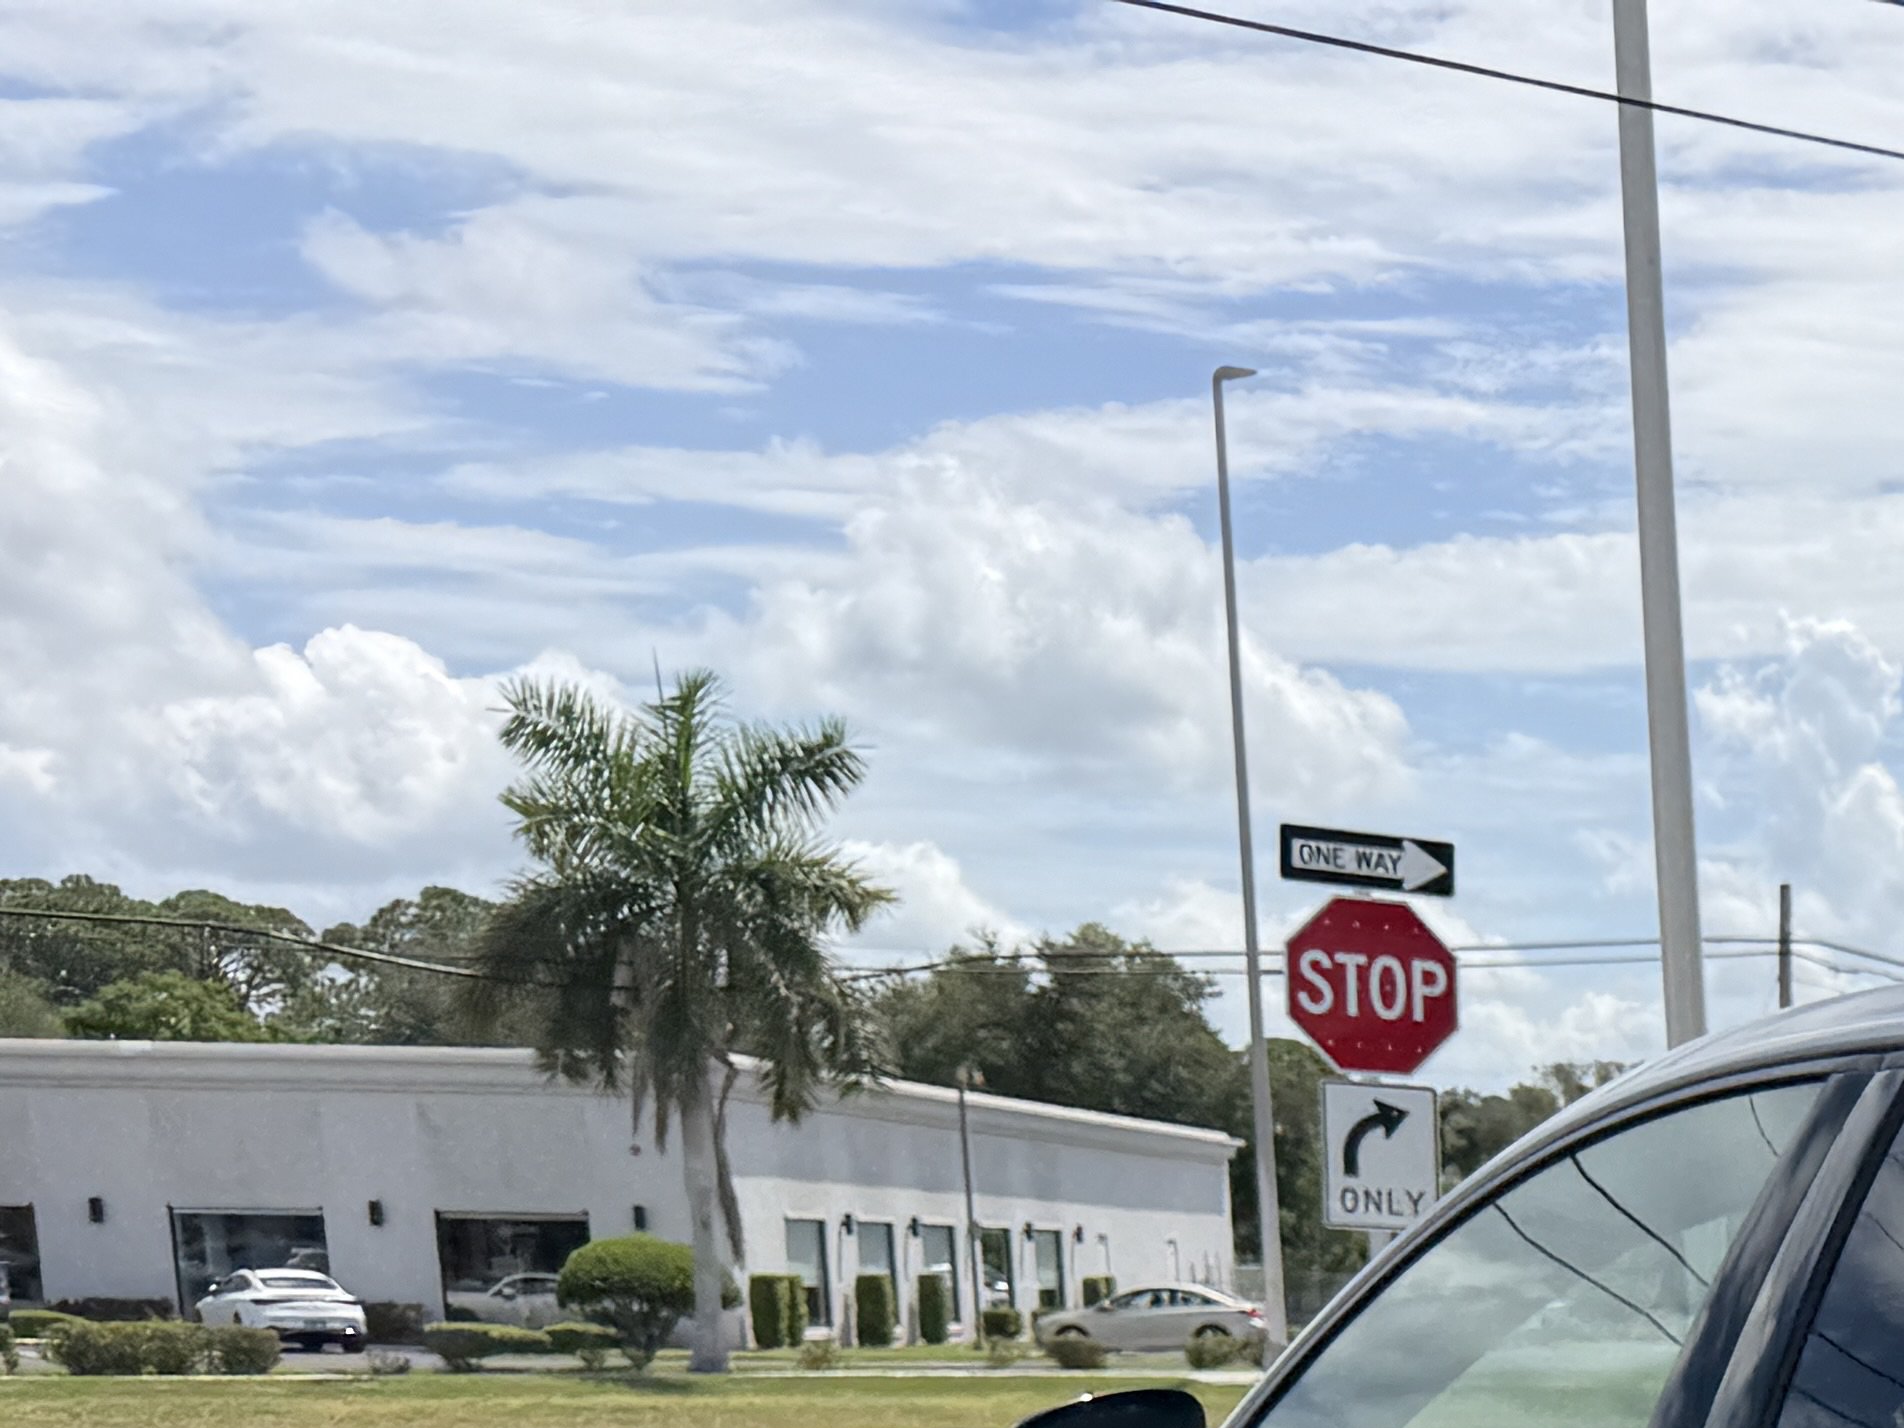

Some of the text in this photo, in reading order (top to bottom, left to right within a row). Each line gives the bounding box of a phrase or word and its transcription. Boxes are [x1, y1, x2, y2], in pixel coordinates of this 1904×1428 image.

[1298, 843, 1402, 875] ONE WAY
[1297, 948, 1447, 1023] STOP
[1340, 1186, 1426, 1217] ONLY
